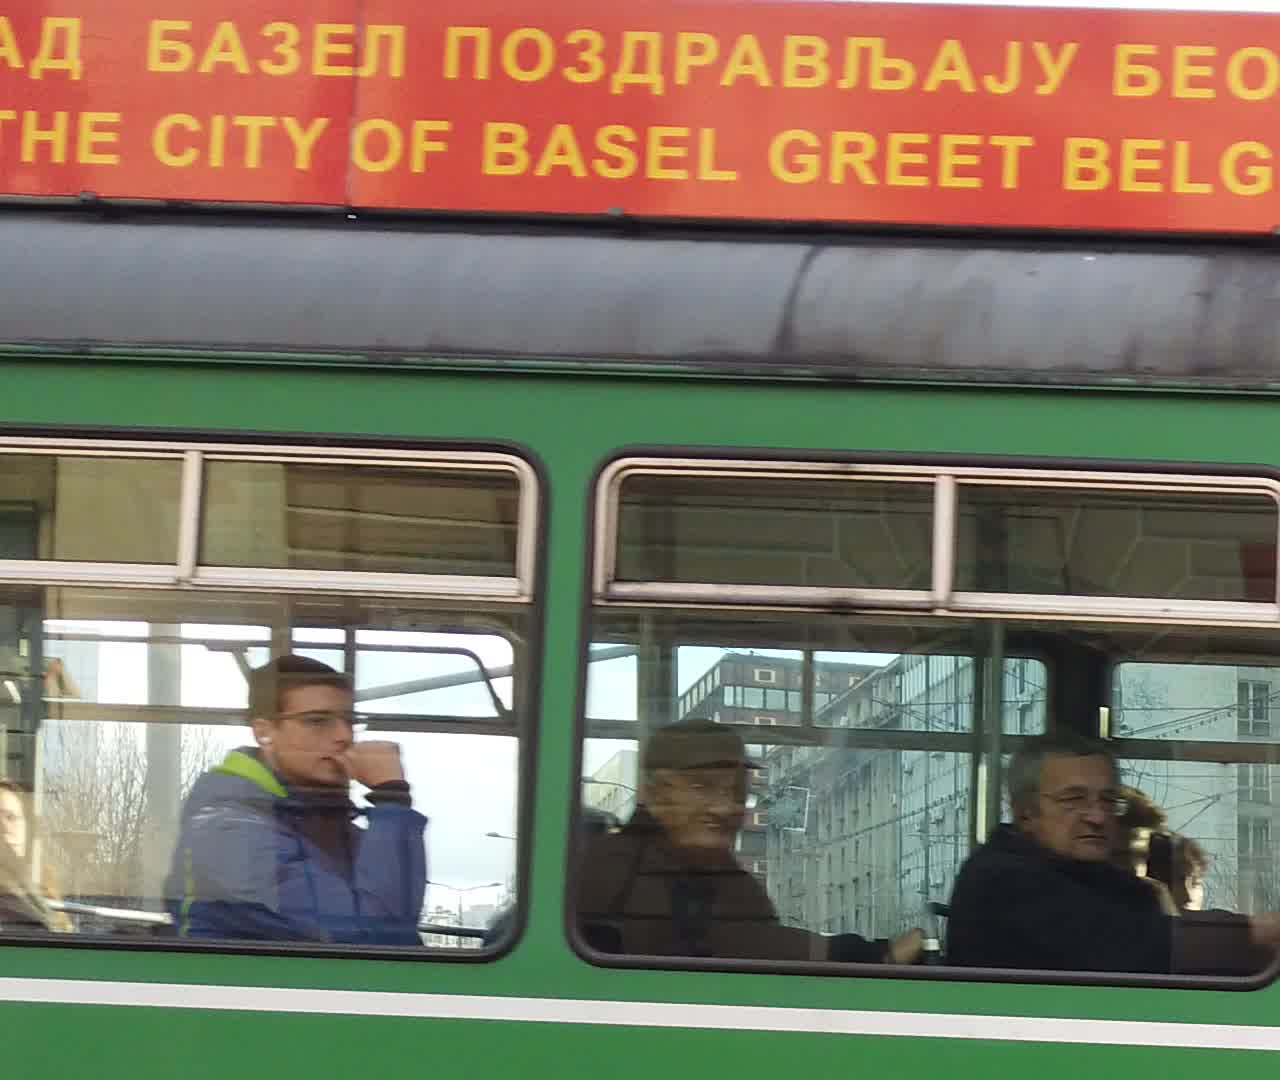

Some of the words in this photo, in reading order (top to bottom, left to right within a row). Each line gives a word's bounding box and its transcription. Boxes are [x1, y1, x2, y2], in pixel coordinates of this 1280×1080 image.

[146, 19, 405, 78] БАЗЕЛ
[444, 26, 1078, 96] ПОЗДРАВЉАЈУ
[152, 113, 329, 170] CITY
[351, 118, 450, 173] OF
[483, 122, 738, 182] BASEL
[768, 129, 1034, 189] GREET
